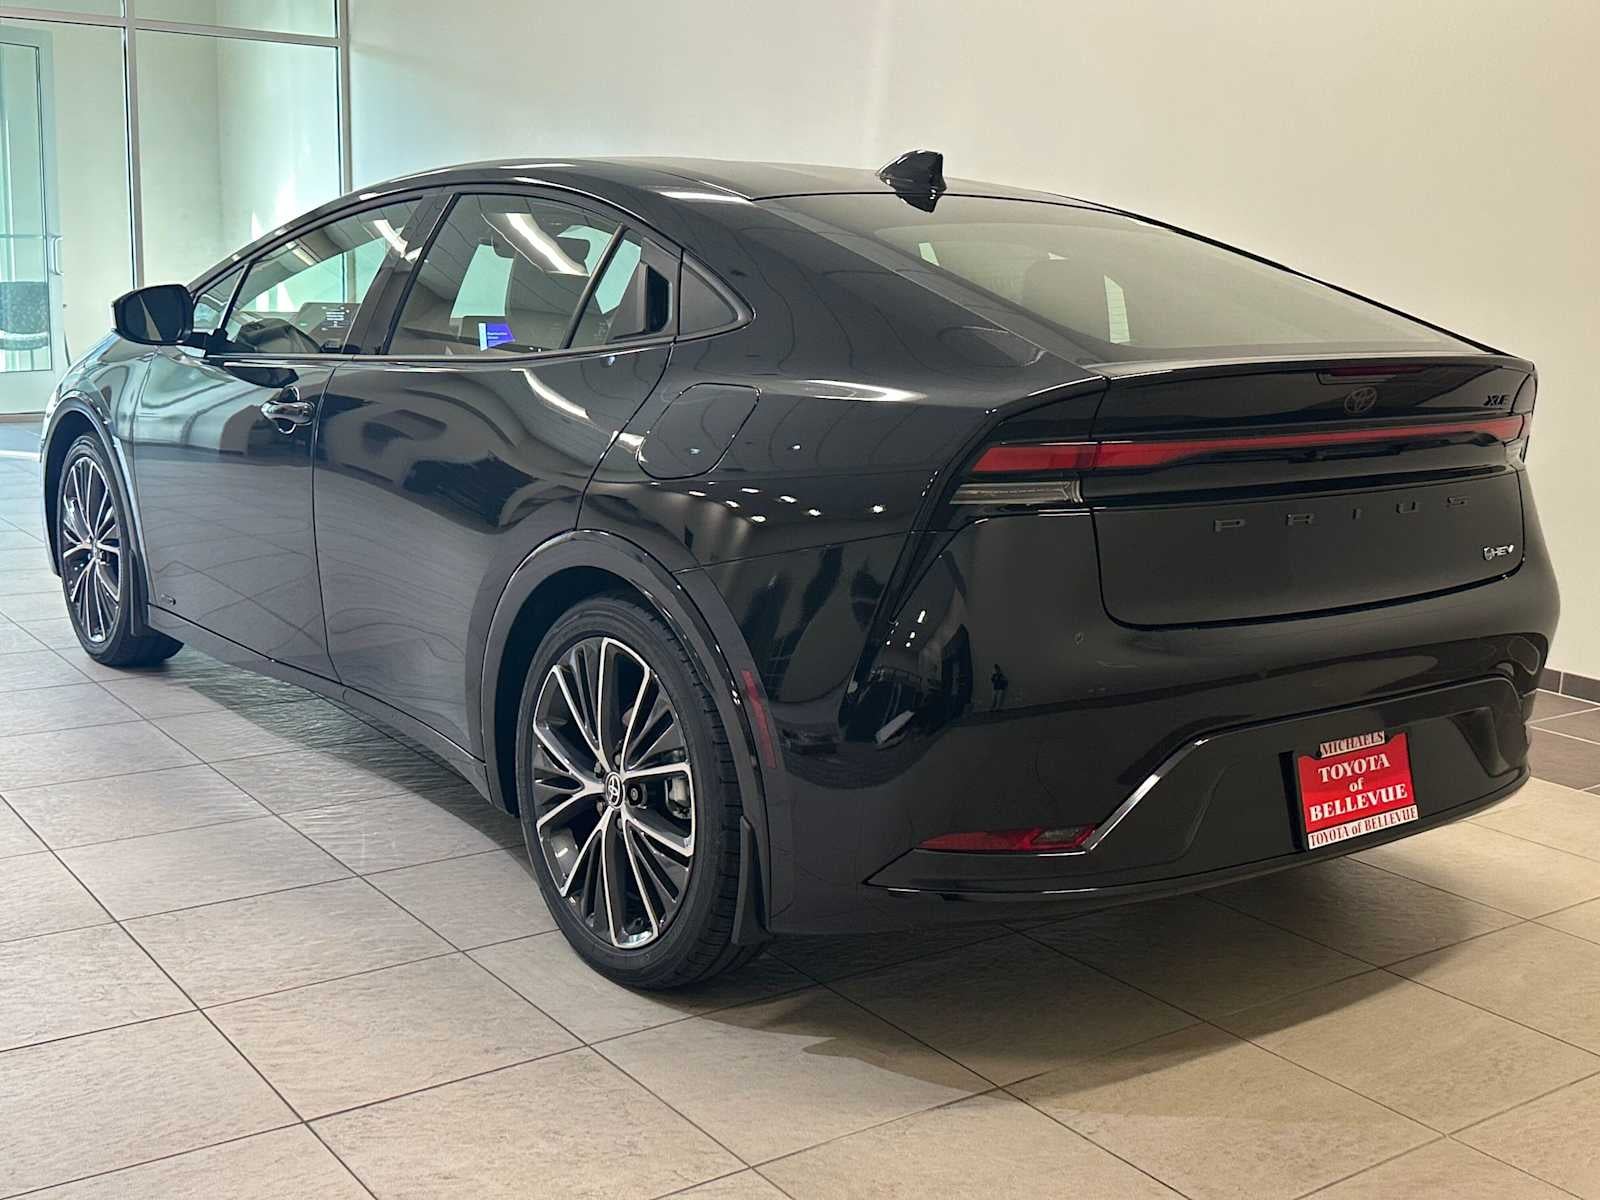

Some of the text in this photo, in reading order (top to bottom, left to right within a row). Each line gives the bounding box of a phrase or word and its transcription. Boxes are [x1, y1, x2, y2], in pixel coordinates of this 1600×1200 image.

[1213, 496, 1470, 532] PRIUS
[1318, 753, 1390, 783] TOYOTA
[1350, 778, 1364, 793] of
[1309, 783, 1408, 822] BELLEVUE
[1310, 807, 1417, 847] TOYOTA of BELLEVUE
